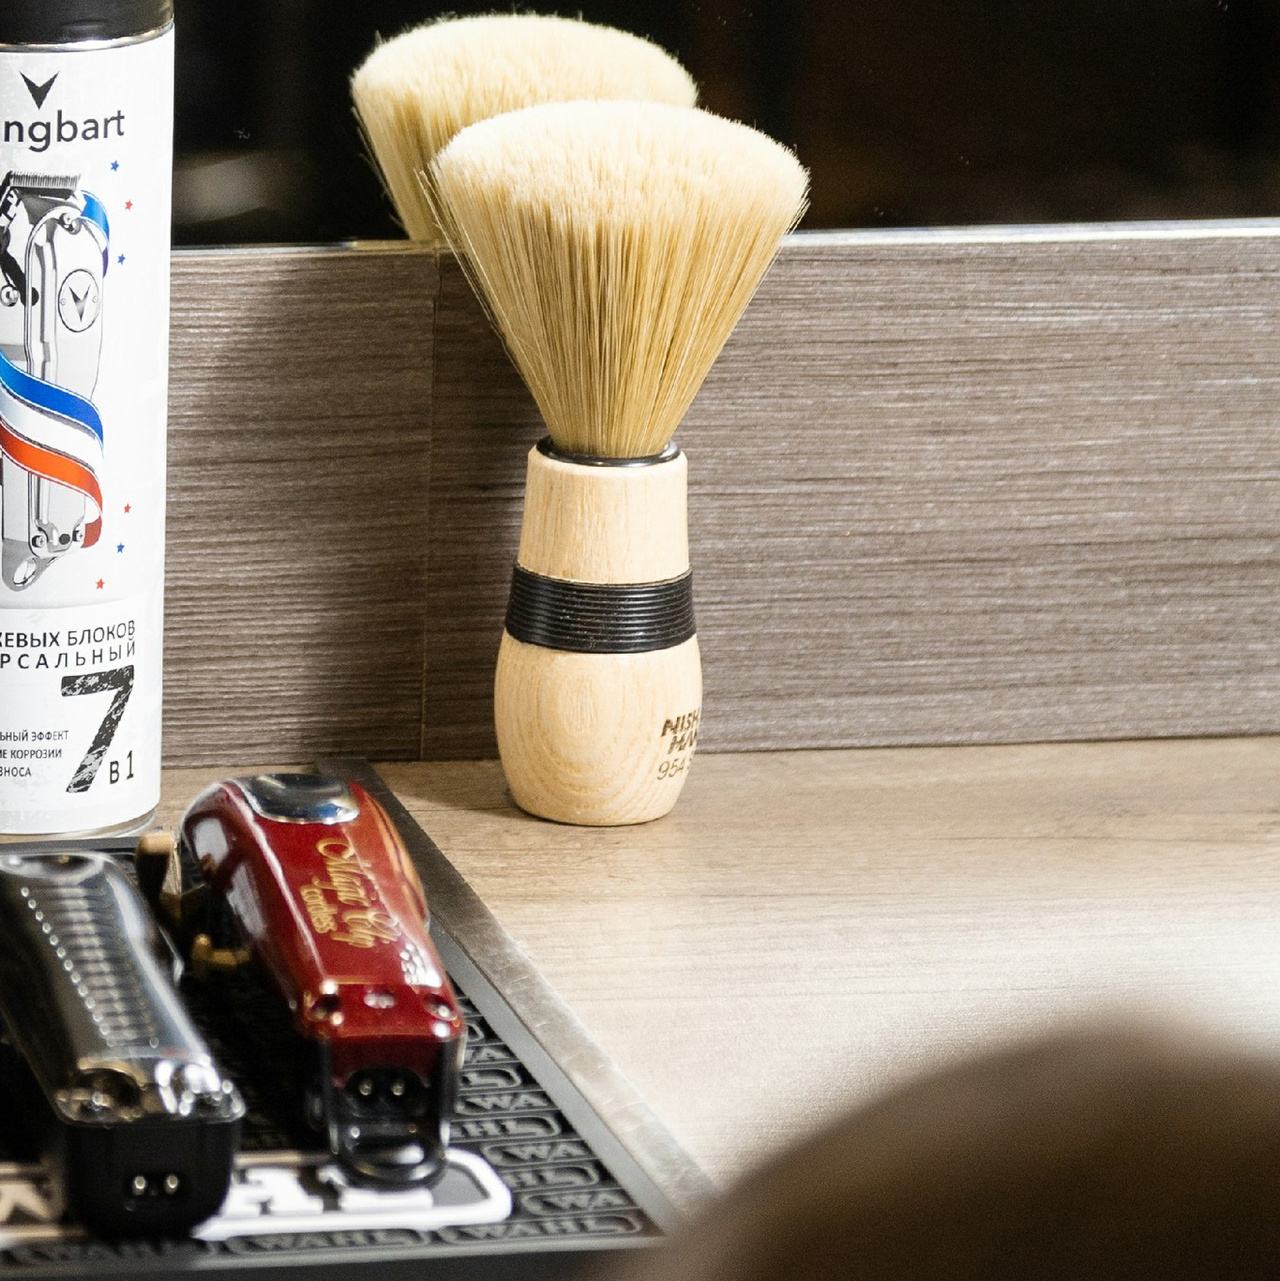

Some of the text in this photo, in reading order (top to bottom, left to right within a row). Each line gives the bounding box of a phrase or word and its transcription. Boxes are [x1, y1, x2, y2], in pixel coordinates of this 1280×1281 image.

[66, 620, 136, 647] БЛОКОВ
[30, 730, 70, 742] ЭФФЕКТ
[61, 664, 135, 794] 7
[125, 750, 135, 781] 1
[10, 748, 63, 759] КОРРОЗИИ
[462, 1214, 618, 1239] WAHL
